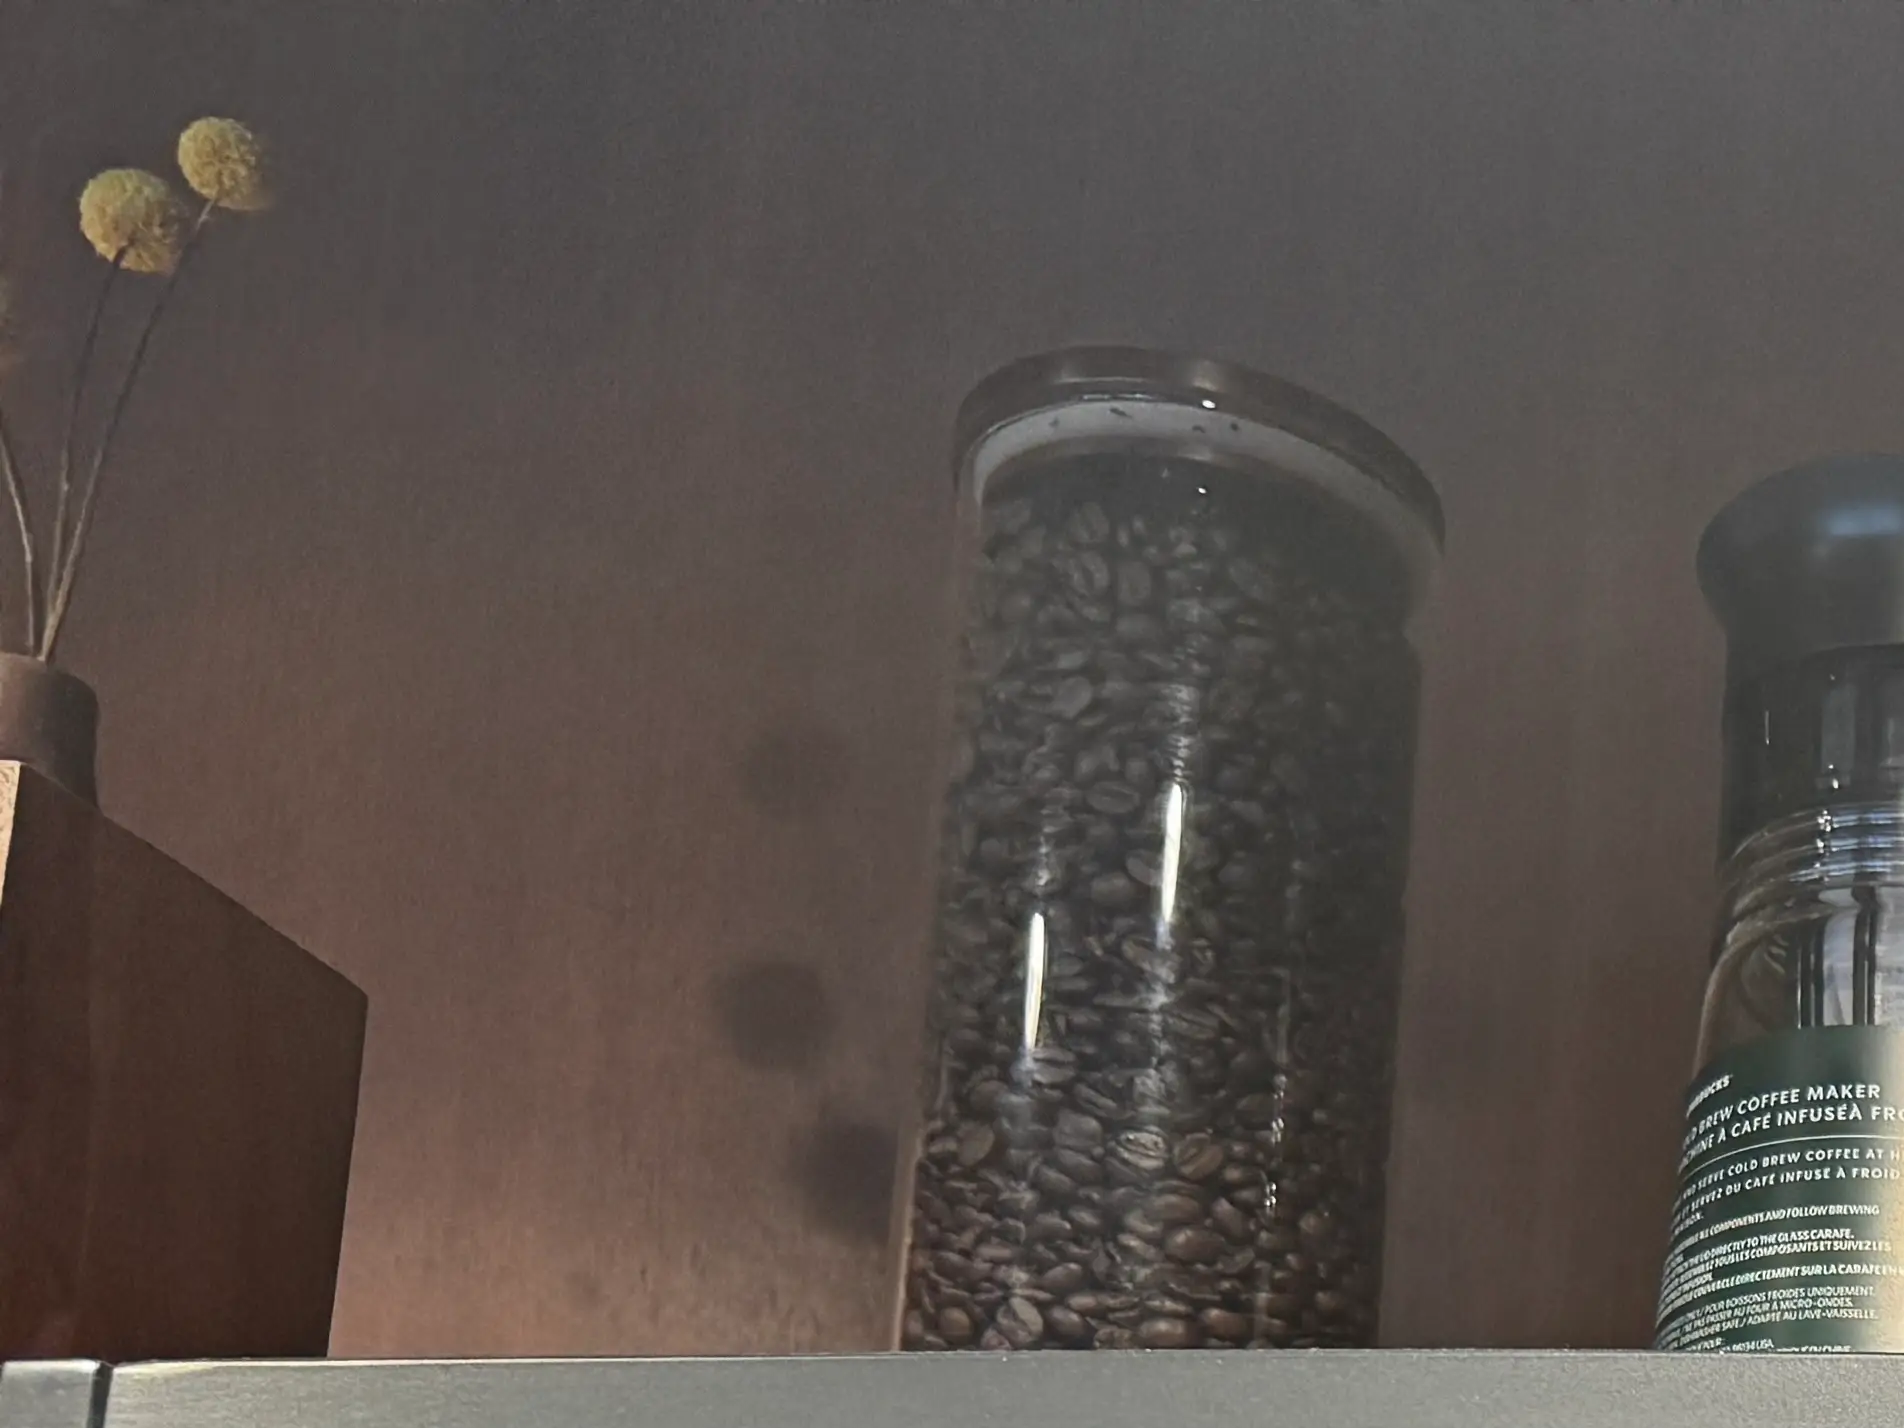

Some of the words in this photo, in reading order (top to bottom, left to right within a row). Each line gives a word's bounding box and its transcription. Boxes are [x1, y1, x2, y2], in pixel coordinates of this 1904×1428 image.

[1737, 1089, 1800, 1115] COFFEE
[1807, 1084, 1880, 1101] MAKER
[1728, 1159, 1757, 1176] COLD
[1762, 1152, 1800, 1168] BREW
[1806, 1148, 1860, 1161] COFFEE
[1866, 1149, 1884, 1160] AT
[1852, 1168, 1900, 1180] FROID
